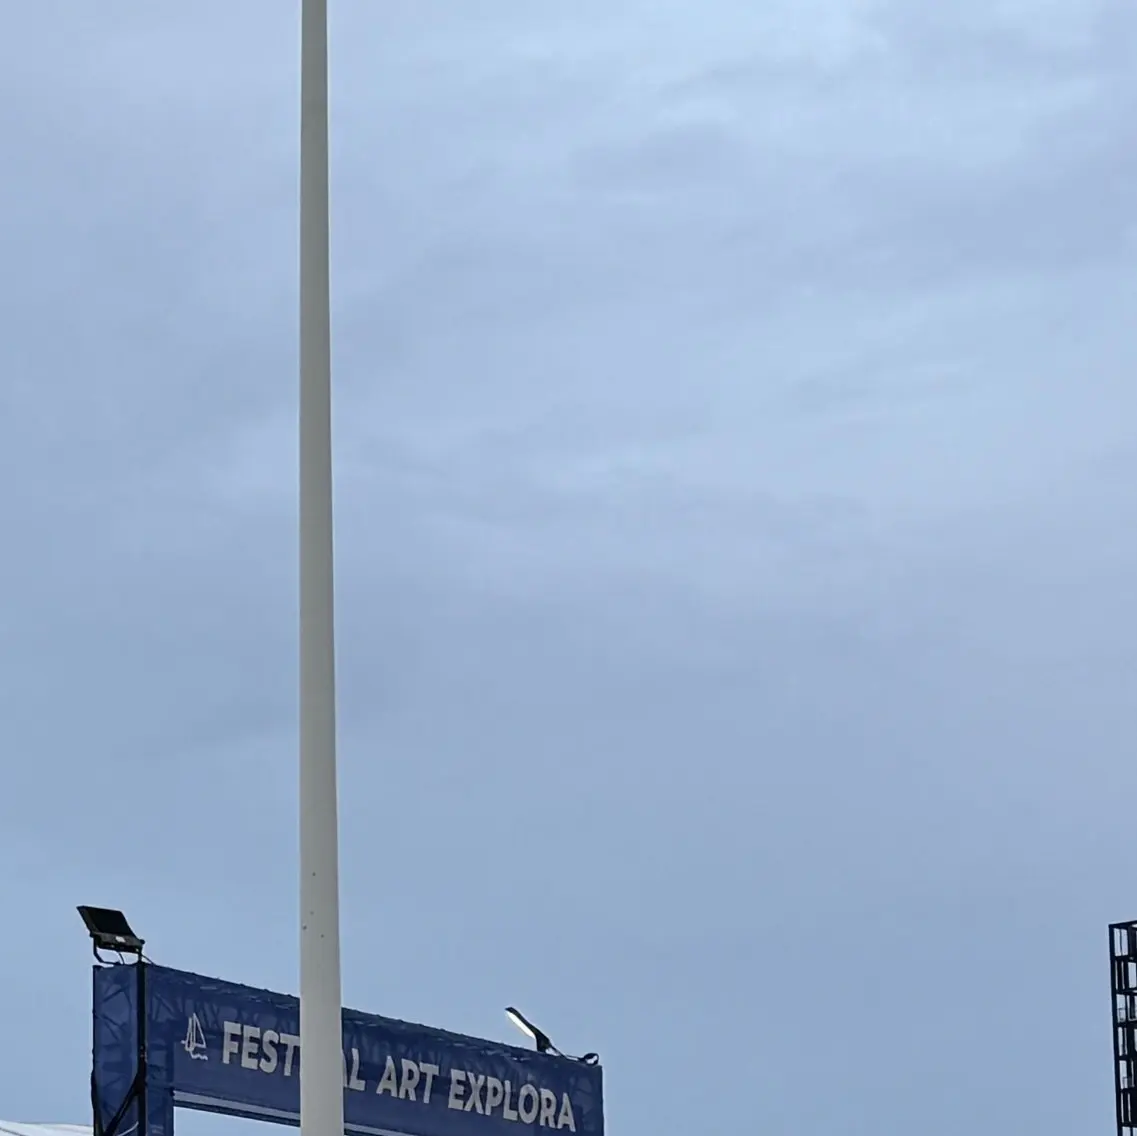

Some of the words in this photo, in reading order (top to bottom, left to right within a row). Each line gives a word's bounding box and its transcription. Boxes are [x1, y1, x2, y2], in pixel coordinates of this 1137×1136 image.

[222, 1020, 365, 1091] FESTL
[376, 1055, 439, 1104] ART
[448, 1068, 576, 1132] EXPLORA
